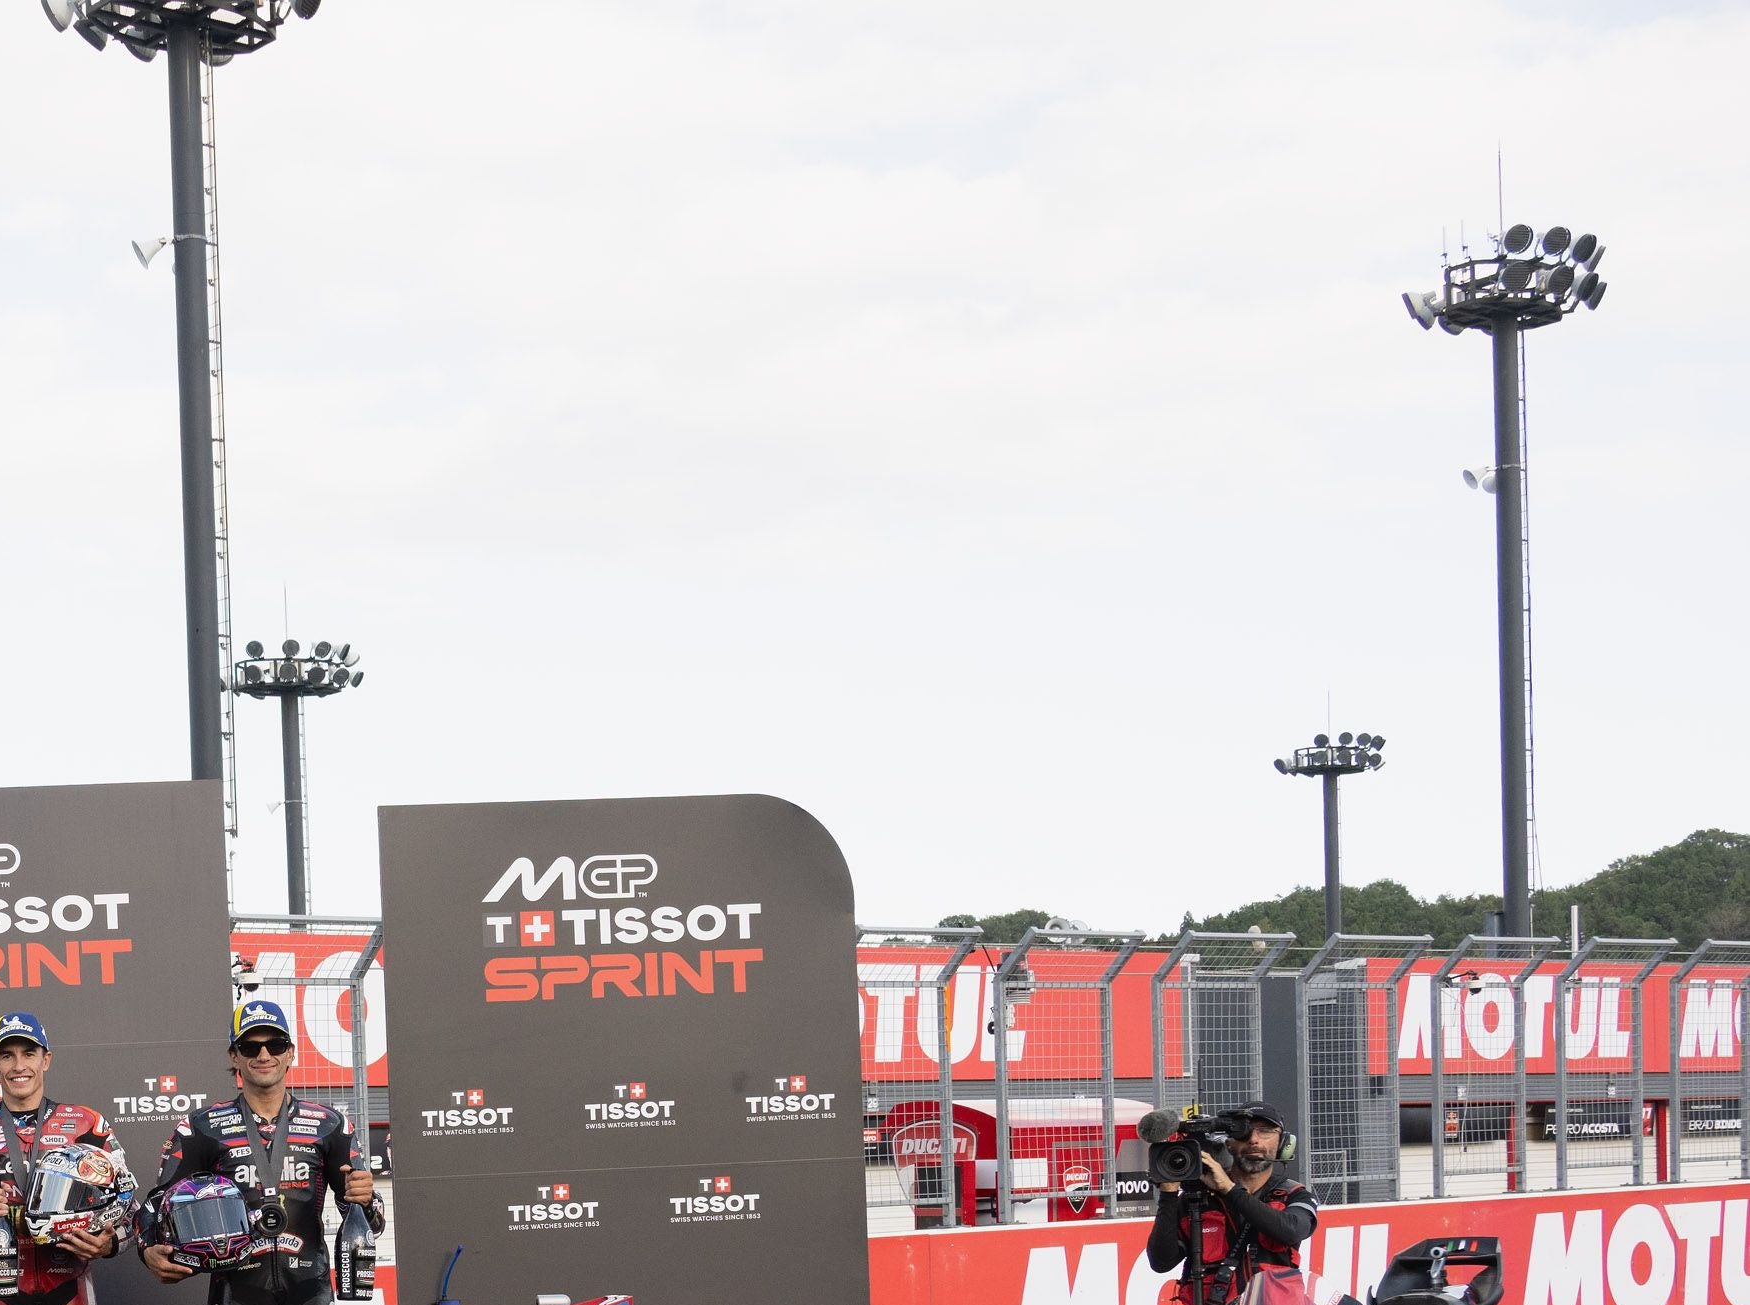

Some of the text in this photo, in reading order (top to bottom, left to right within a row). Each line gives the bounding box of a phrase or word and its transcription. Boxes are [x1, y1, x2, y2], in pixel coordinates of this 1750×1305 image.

[561, 903, 762, 945] TISSOT
[484, 948, 764, 1003] SPRINT
[1398, 973, 1631, 1060] MOTUL
[113, 1094, 207, 1115] TISSOT
[584, 1100, 675, 1121] TISSOT
[745, 1093, 836, 1114] TISSOT
[421, 1107, 514, 1128] TISSOT
[607, 1121, 639, 1129] WATCHES
[1581, 1122, 1620, 1134] ACOSTA
[1689, 1120, 1713, 1130] BRAD
[444, 1128, 477, 1136] WATCHES
[1066, 1173, 1088, 1181] DUCATI
[508, 1201, 599, 1222] TISSOT
[669, 1194, 760, 1215] TISSOT
[57, 1218, 87, 1231] Lenovo
[508, 1223, 529, 1231] SWISS
[530, 1222, 562, 1230] WATCHES
[585, 1220, 600, 1228] 1853
[342, 1252, 351, 1293] PROSECCO
